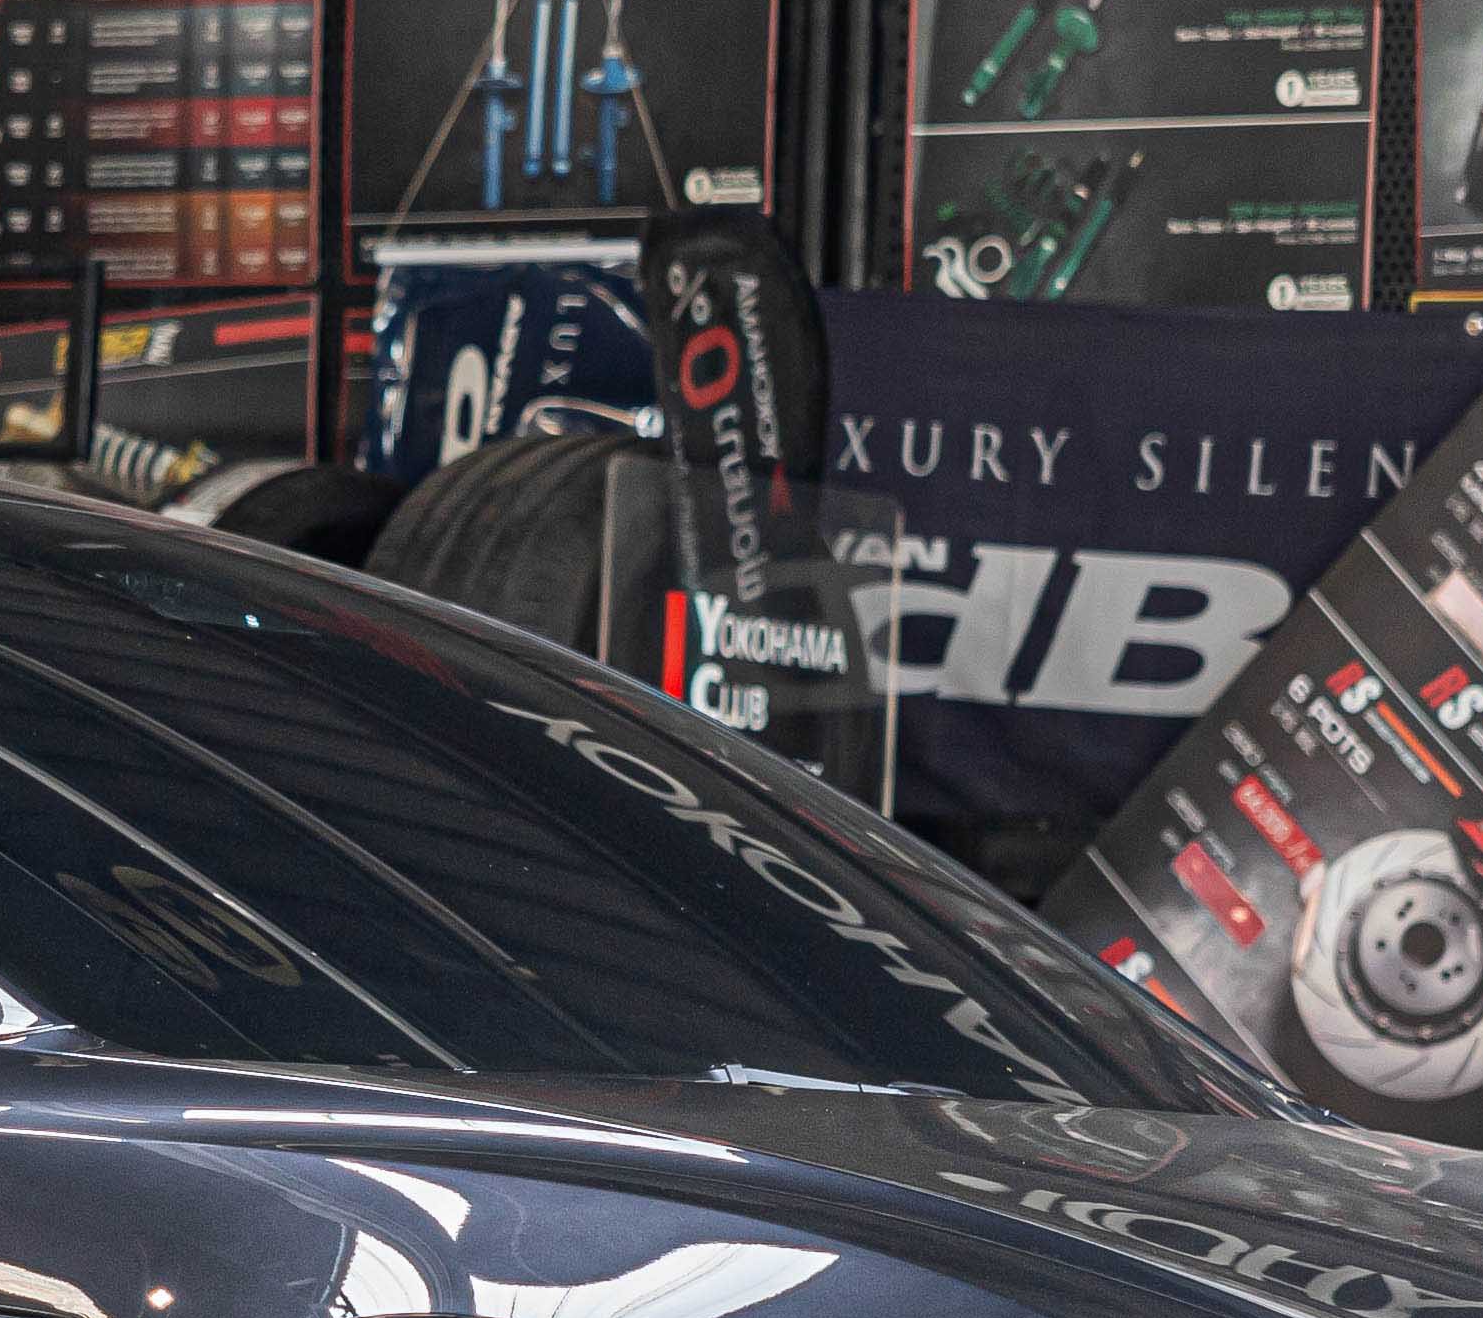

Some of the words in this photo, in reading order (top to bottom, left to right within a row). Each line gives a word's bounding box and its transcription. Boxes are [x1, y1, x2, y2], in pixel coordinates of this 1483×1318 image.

[836, 411, 1070, 486] XURY
[1137, 429, 1418, 499] SILEN
[696, 591, 849, 674] YOKOHAMA
[691, 664, 769, 732] CLUB
